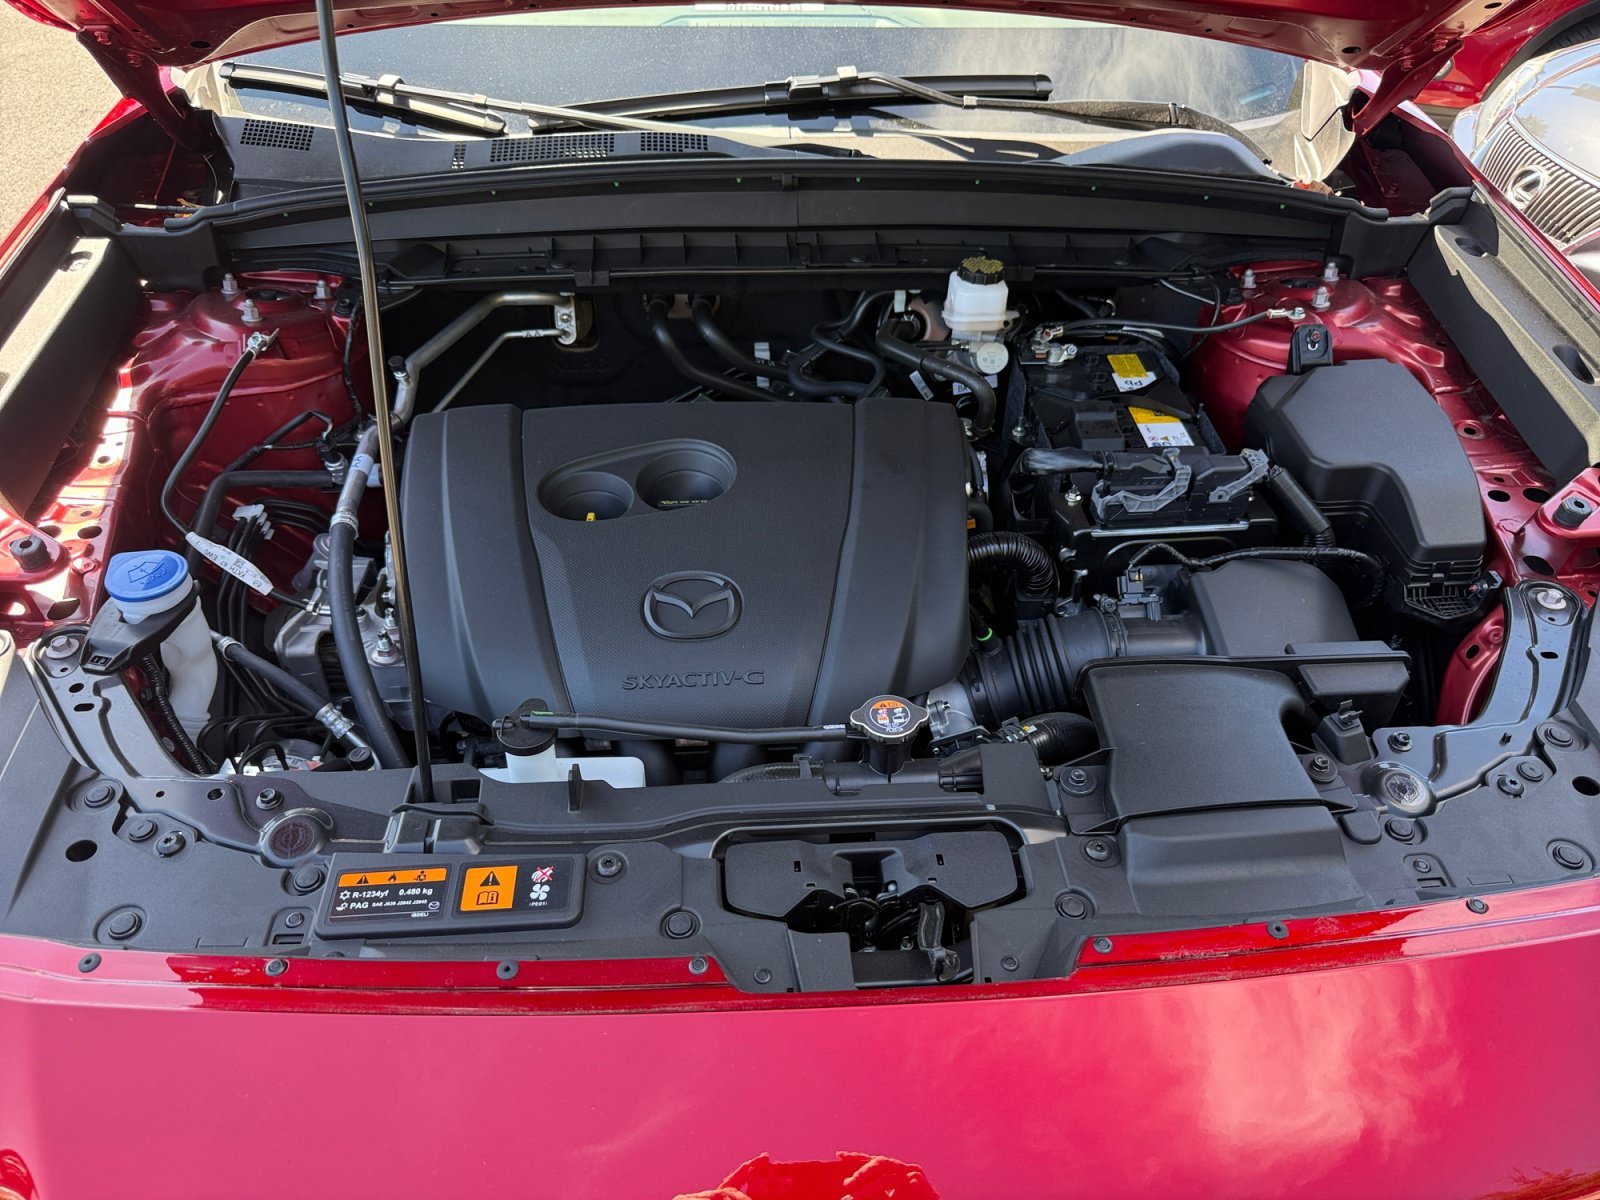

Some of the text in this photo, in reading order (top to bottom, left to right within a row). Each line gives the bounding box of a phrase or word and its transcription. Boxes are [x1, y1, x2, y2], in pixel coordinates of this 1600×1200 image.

[1124, 379, 1143, 387] Pb
[622, 670, 765, 690] SKYACTIV-G
[352, 887, 434, 900] R-1234yf 0.480 kg
[349, 902, 369, 910] PAG
